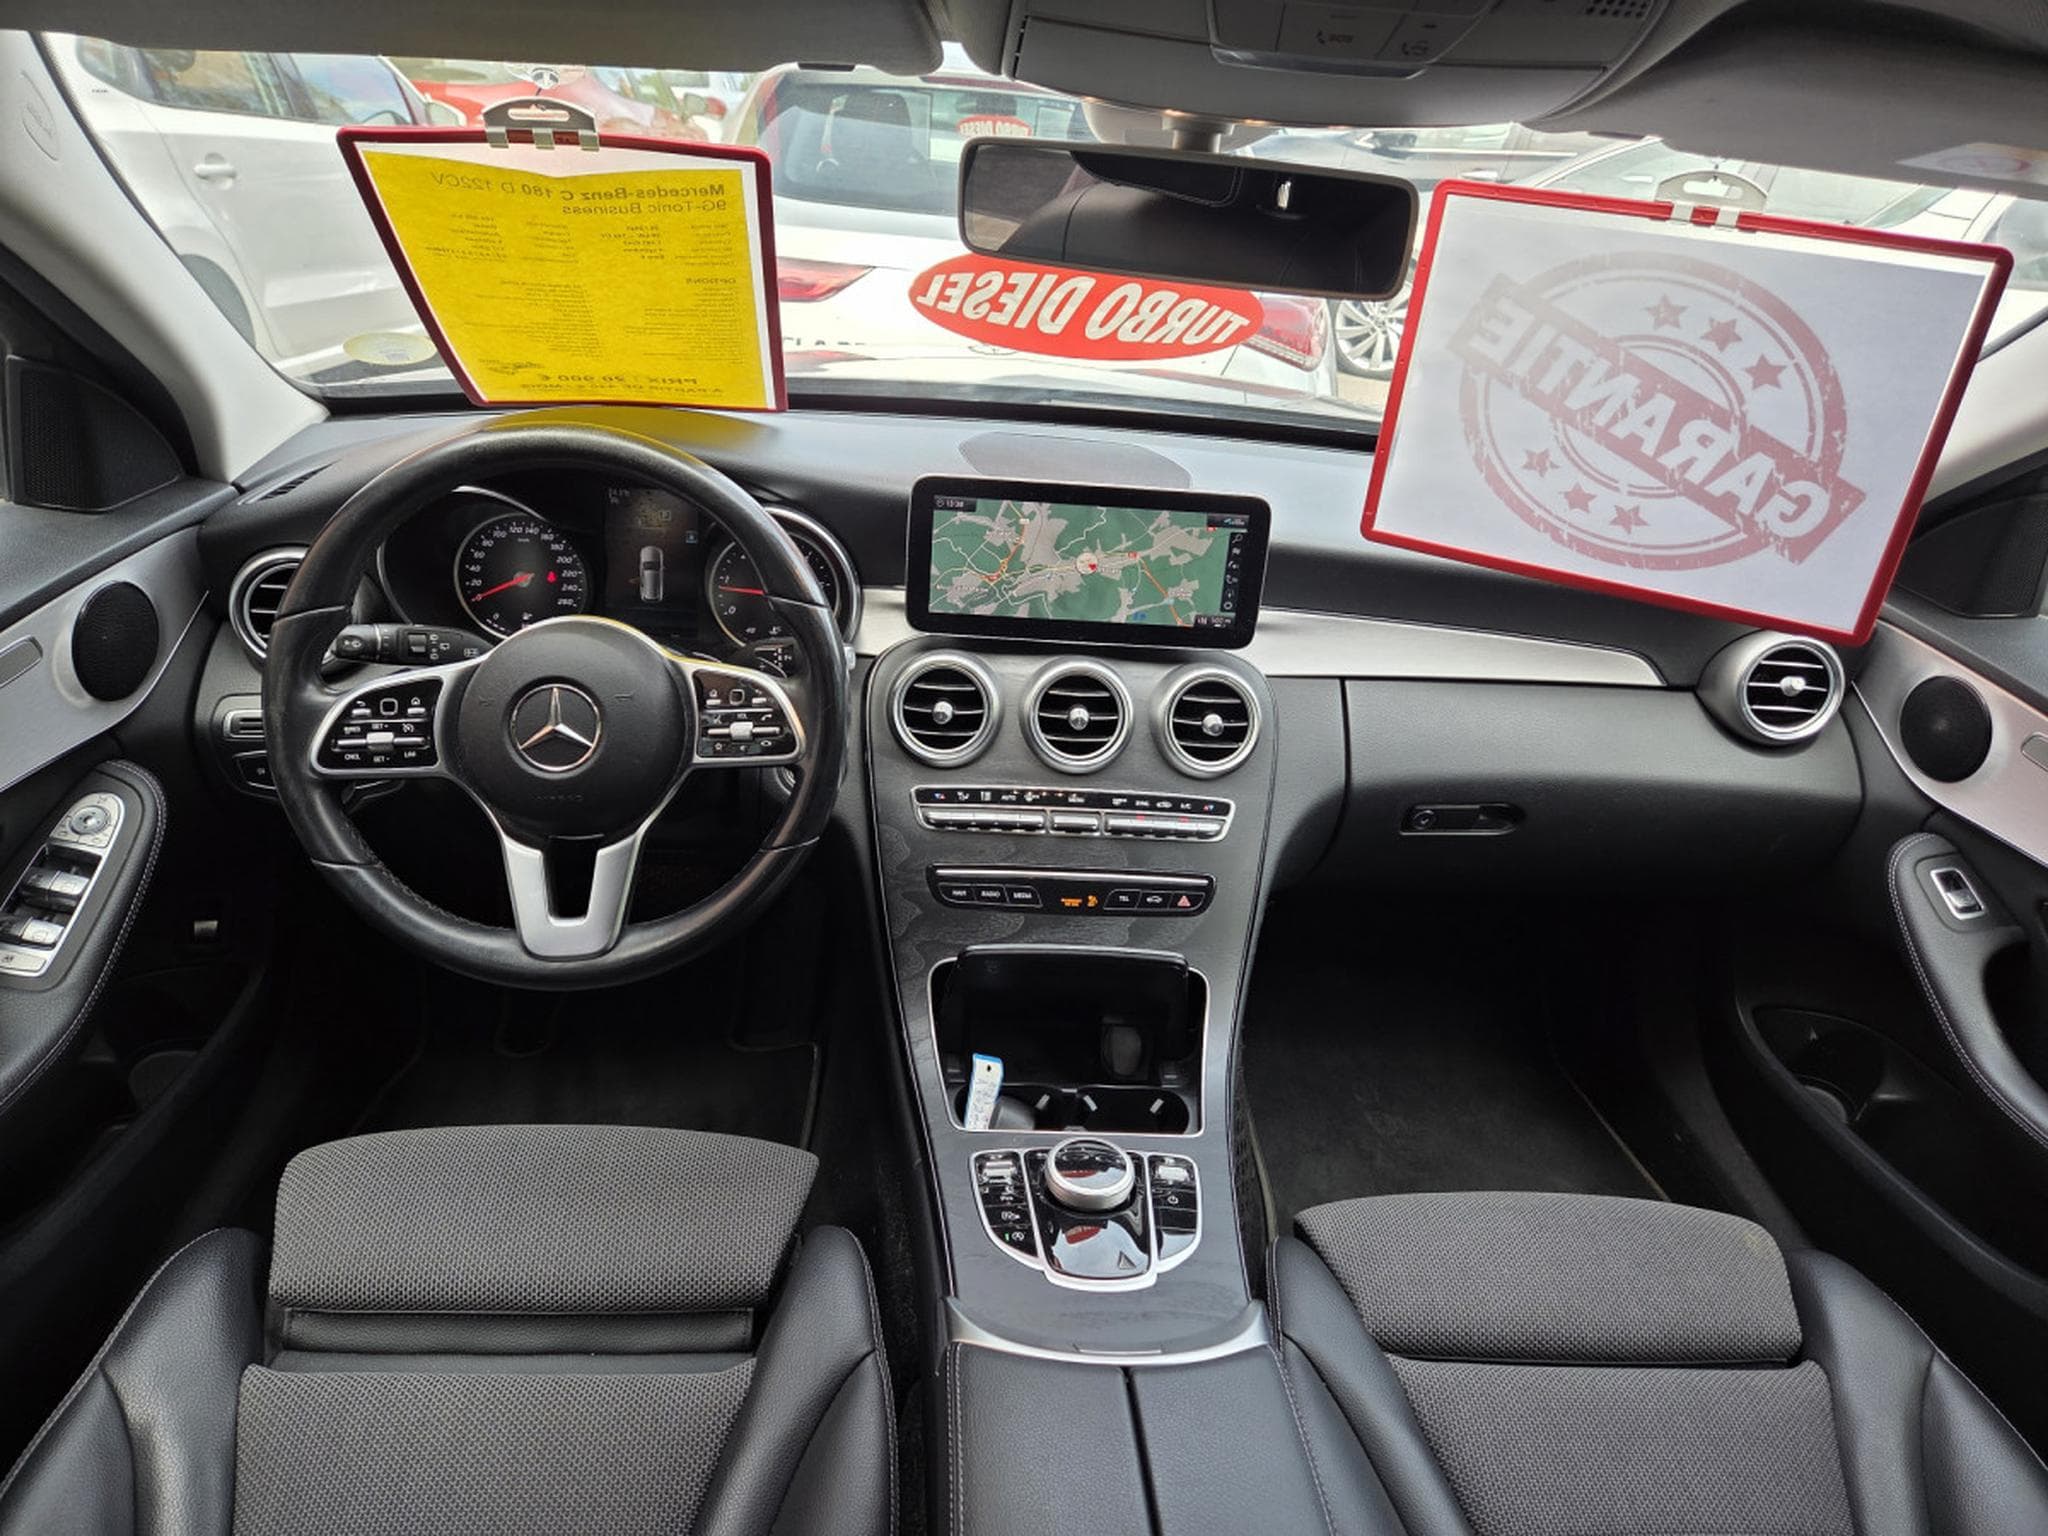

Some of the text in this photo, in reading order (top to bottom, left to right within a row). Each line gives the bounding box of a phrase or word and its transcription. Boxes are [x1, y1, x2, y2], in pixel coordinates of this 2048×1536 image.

[493, 530, 508, 538] 100
[525, 526, 540, 534] 140
[482, 539, 494, 547] 80
[473, 550, 485, 559] 60
[562, 570, 578, 578] 220
[728, 605, 737, 615] 0
